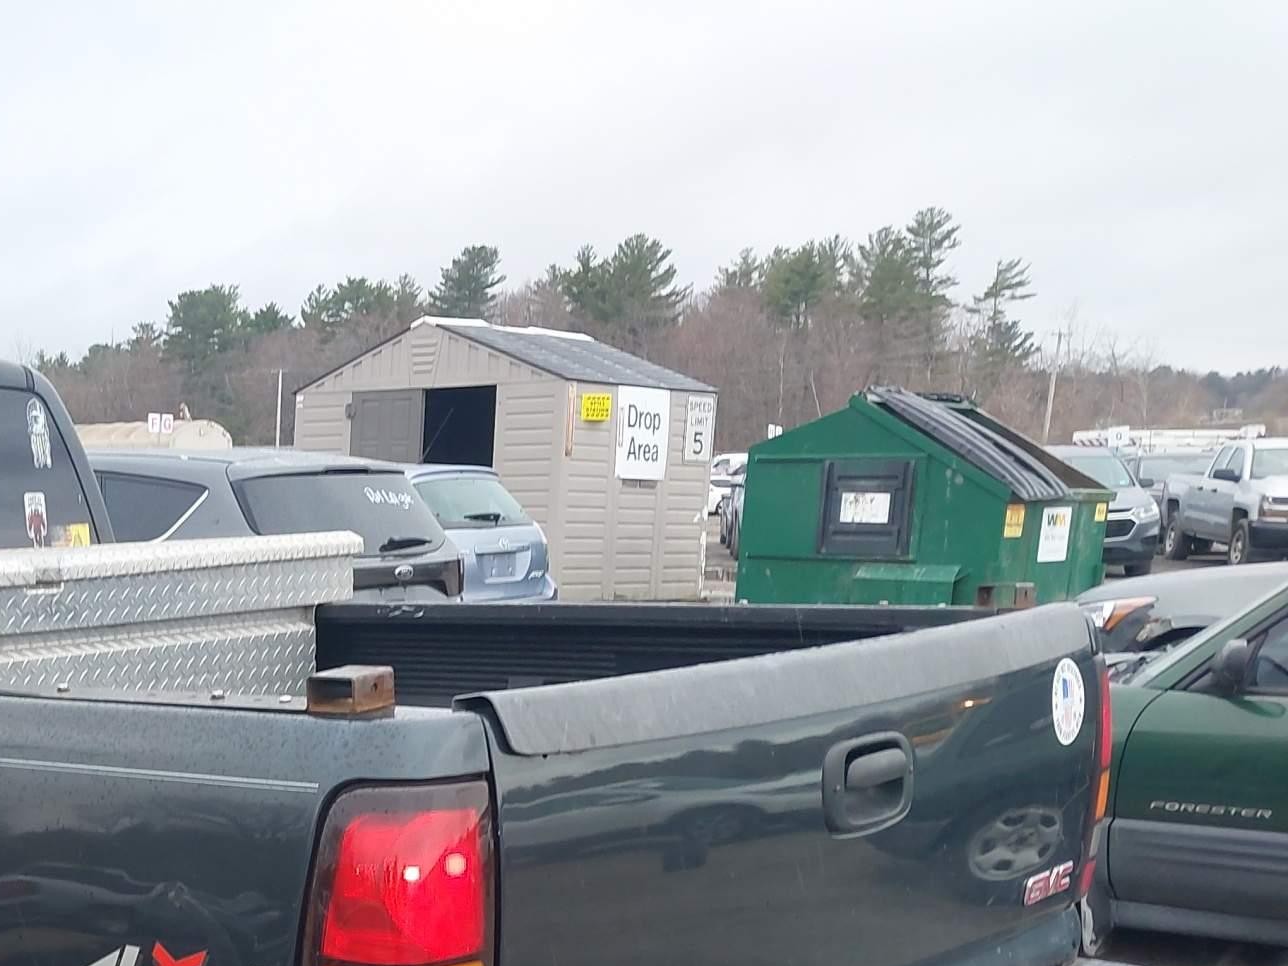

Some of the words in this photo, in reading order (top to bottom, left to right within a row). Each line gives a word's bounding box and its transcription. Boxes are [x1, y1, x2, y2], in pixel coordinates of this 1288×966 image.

[689, 401, 713, 414] SPEED
[627, 404, 661, 436] Drop
[690, 417, 709, 427] LIMIT
[626, 436, 659, 463] Area
[692, 432, 704, 455] 5
[1047, 513, 1067, 527] WM
[1149, 800, 1273, 819] FORESTER
[1023, 860, 1074, 906] GMC
